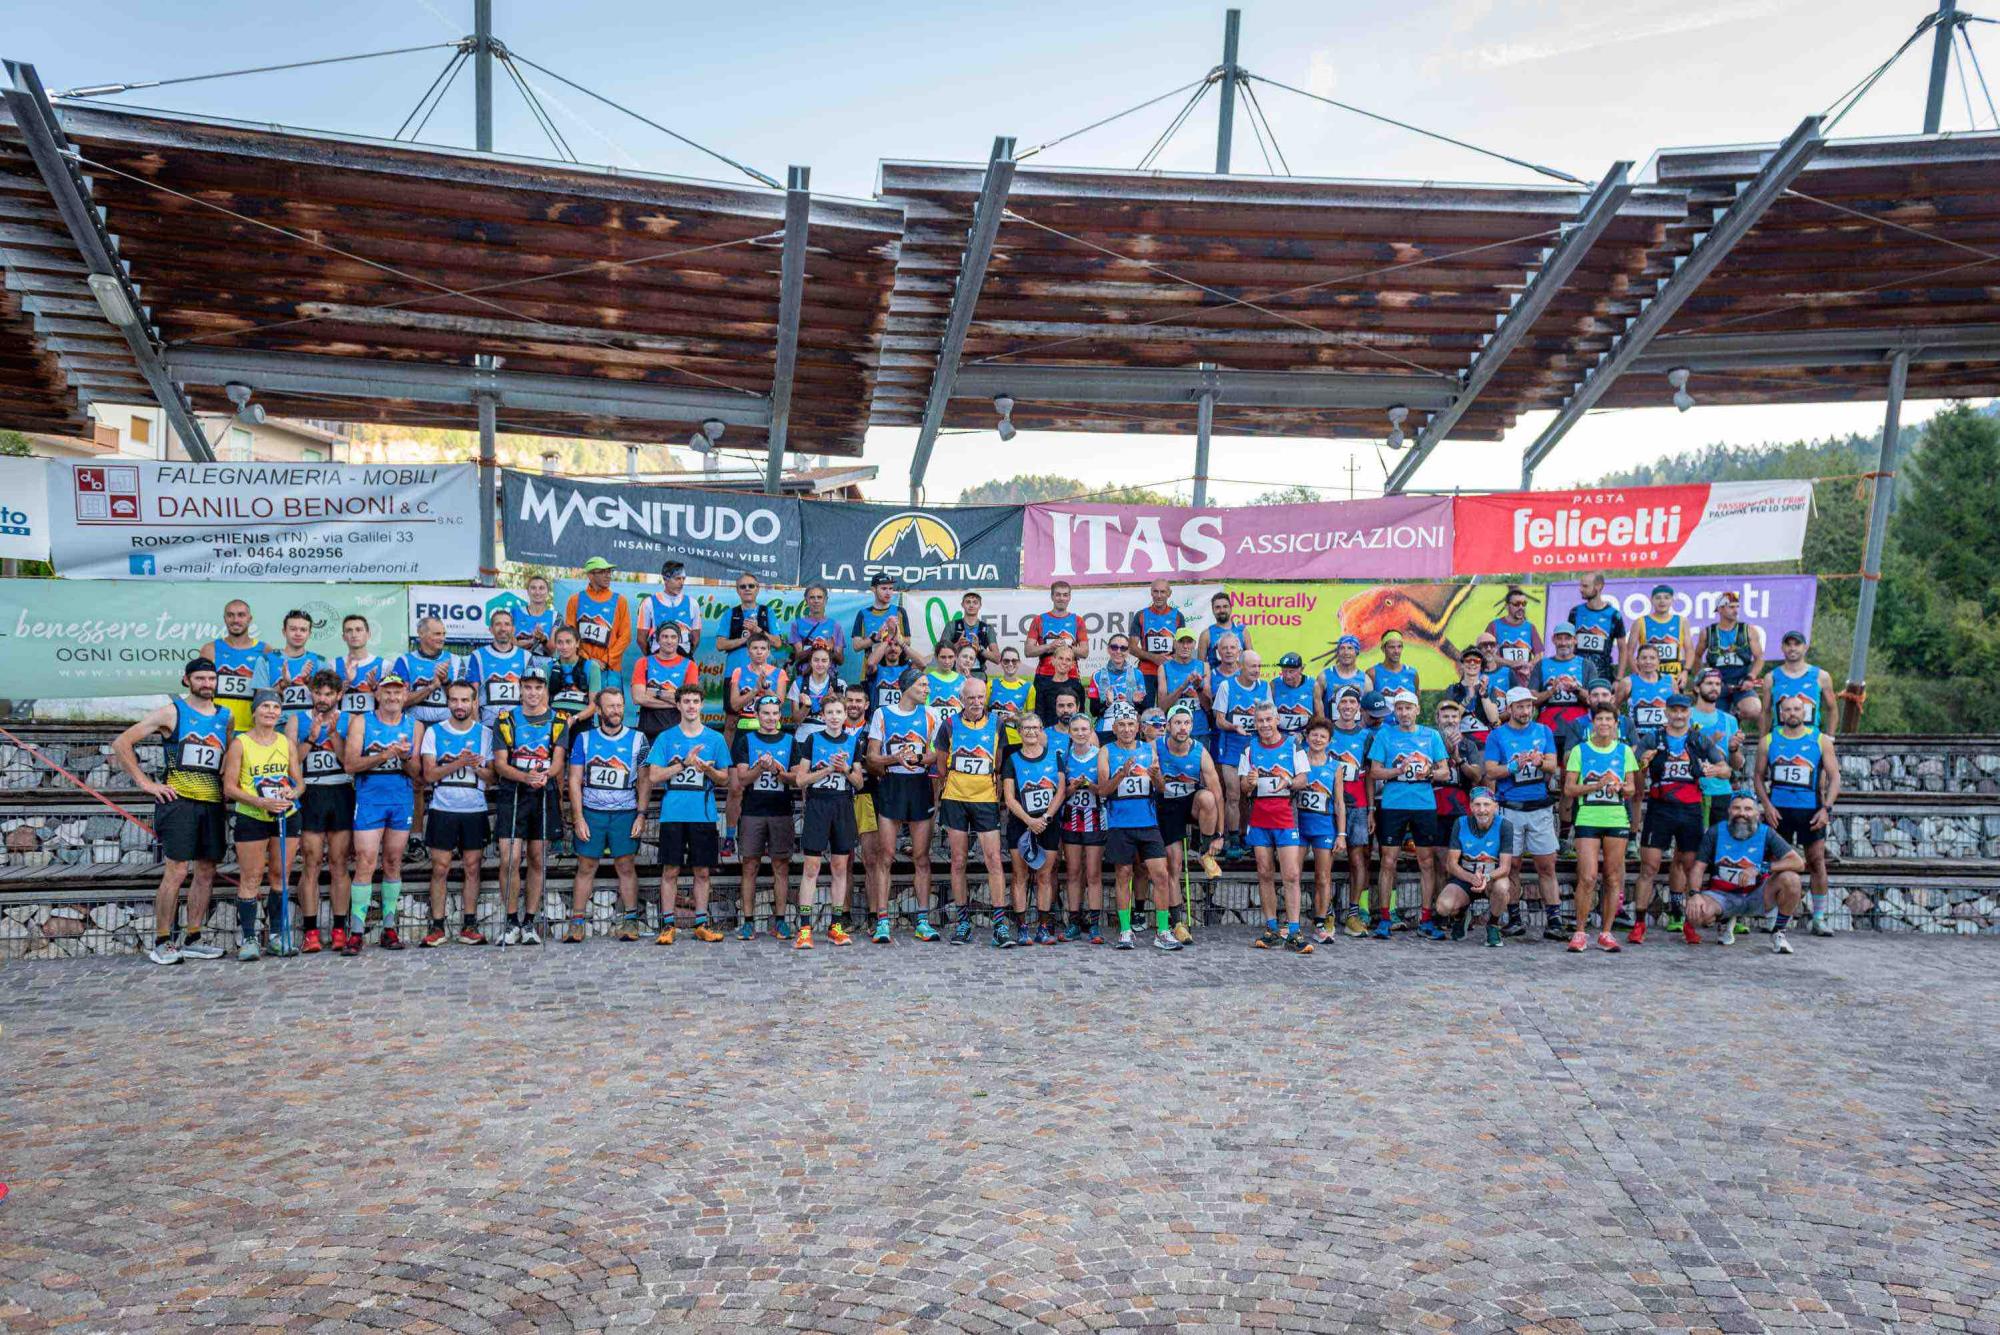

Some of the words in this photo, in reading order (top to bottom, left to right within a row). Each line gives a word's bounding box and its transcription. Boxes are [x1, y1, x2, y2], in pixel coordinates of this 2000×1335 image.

[158, 467, 342, 486] FALEGNAMERIA
[363, 468, 438, 485] MOBILI
[1573, 493, 1626, 504] PASTA
[158, 496, 273, 518] DANILO
[284, 495, 394, 518] BENONI
[400, 502, 411, 514] &
[417, 502, 435, 514] C.
[520, 477, 781, 546] MAGNITUDO
[1513, 505, 1682, 553] felicetti
[132, 532, 270, 548] RONZO-CHIENIS
[275, 531, 308, 545] (TN)
[323, 531, 343, 544] via
[348, 530, 392, 544] Galilei
[396, 530, 414, 543] 33
[1049, 511, 1226, 576] ITAS
[1236, 526, 1445, 556] ASSICURAZIONI
[212, 547, 242, 559] Tel.
[247, 547, 284, 558] 0464
[288, 547, 343, 558] 802956
[613, 539, 662, 552] INSANE
[667, 545, 734, 559] MOUNTAIN
[739, 553, 776, 563] VIBES
[1533, 552, 1613, 565] DOLOMITI
[1621, 550, 1659, 562] 1908
[163, 562, 215, 574] e-mail:
[220, 562, 418, 576] info@falegnameriabenoni.it
[821, 563, 856, 581] LA
[863, 563, 999, 584] SPORTIVA
[1230, 591, 1317, 611] Naturally
[416, 603, 482, 621] FRIGO
[1231, 610, 1302, 626] curious
[16, 609, 154, 644] benessere
[155, 611, 261, 641] terme
[584, 625, 600, 640] 44
[1153, 638, 1168, 650] 54
[1584, 635, 1599, 648] 26
[56, 648, 112, 662] OGNI
[119, 648, 201, 662] GIORNO
[1511, 649, 1524, 661] 18
[225, 677, 247, 693] 55
[500, 684, 515, 699] 21
[285, 688, 306, 703] 24
[349, 695, 366, 709] 19
[885, 691, 900, 705] 49
[1285, 715, 1302, 729] 74
[1470, 717, 1478, 729] 2
[1645, 709, 1662, 722] 75
[196, 749, 214, 766] 12
[313, 753, 334, 769] 50
[249, 765, 259, 777] LE
[263, 763, 287, 774] SELV
[963, 759, 983, 774] 57
[1522, 763, 1538, 777] 47
[1669, 764, 1687, 776] 85
[1783, 767, 1801, 781] 15
[597, 770, 618, 785] 40
[676, 768, 696, 783] 52
[760, 773, 779, 789] 53
[819, 773, 839, 789] 25
[1127, 778, 1144, 793] 31
[1171, 782, 1188, 796] 71
[1033, 791, 1050, 807] 59
[1073, 791, 1090, 807] 58
[1301, 792, 1320, 809] 62
